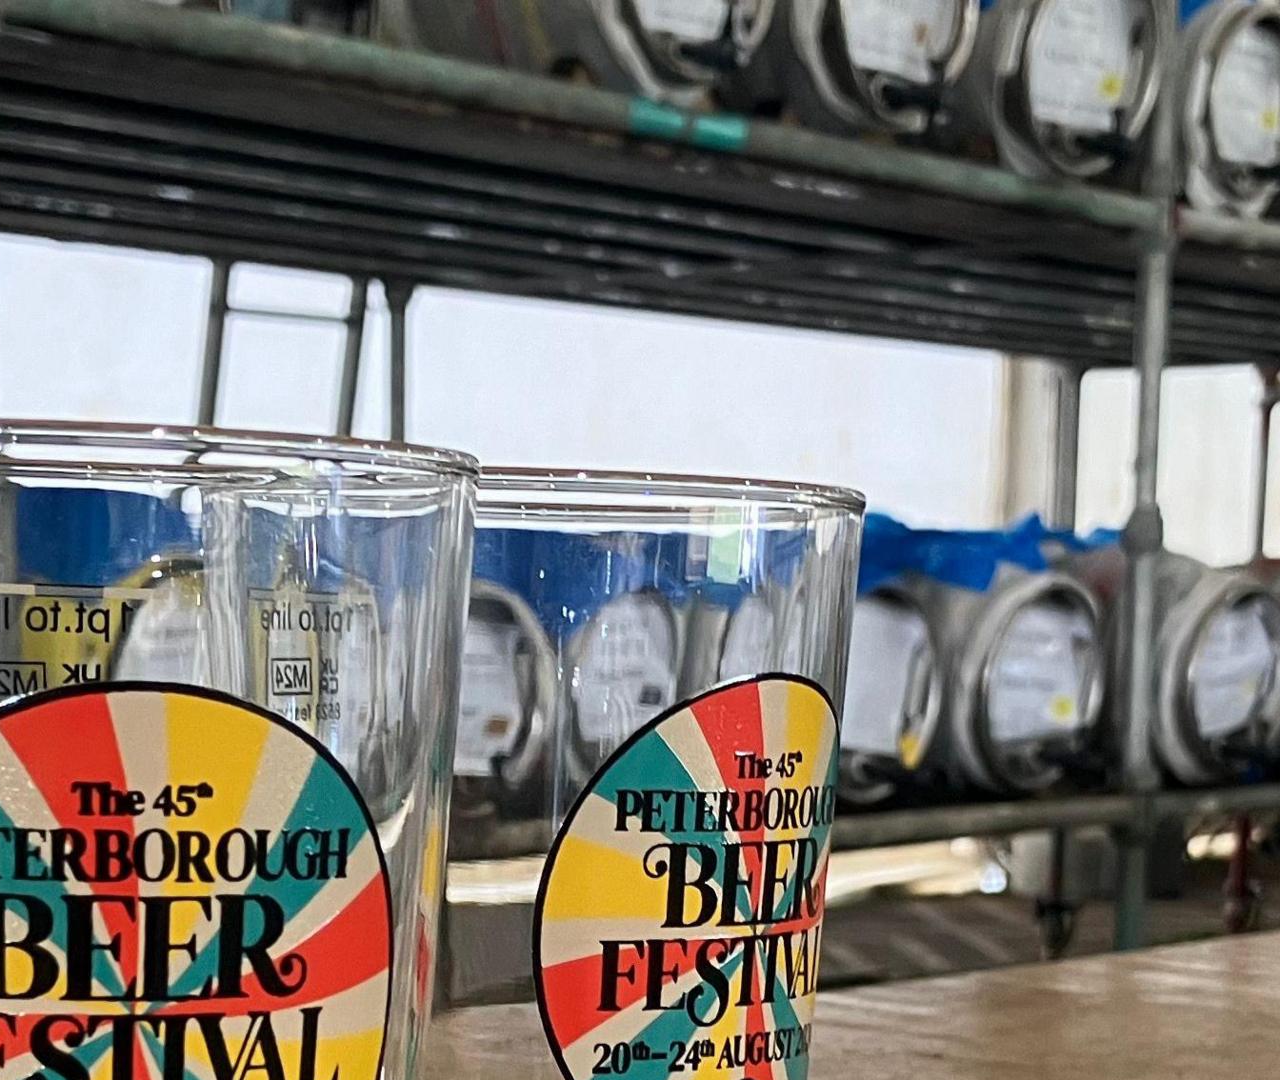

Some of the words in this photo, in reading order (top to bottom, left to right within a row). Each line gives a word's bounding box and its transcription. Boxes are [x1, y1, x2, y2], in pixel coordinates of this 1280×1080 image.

[734, 750, 773, 779] The
[71, 781, 146, 817] The
[614, 785, 834, 833] PETERBOROUG
[643, 838, 820, 929] BEER
[716, 1029, 795, 1069] AUGUST
